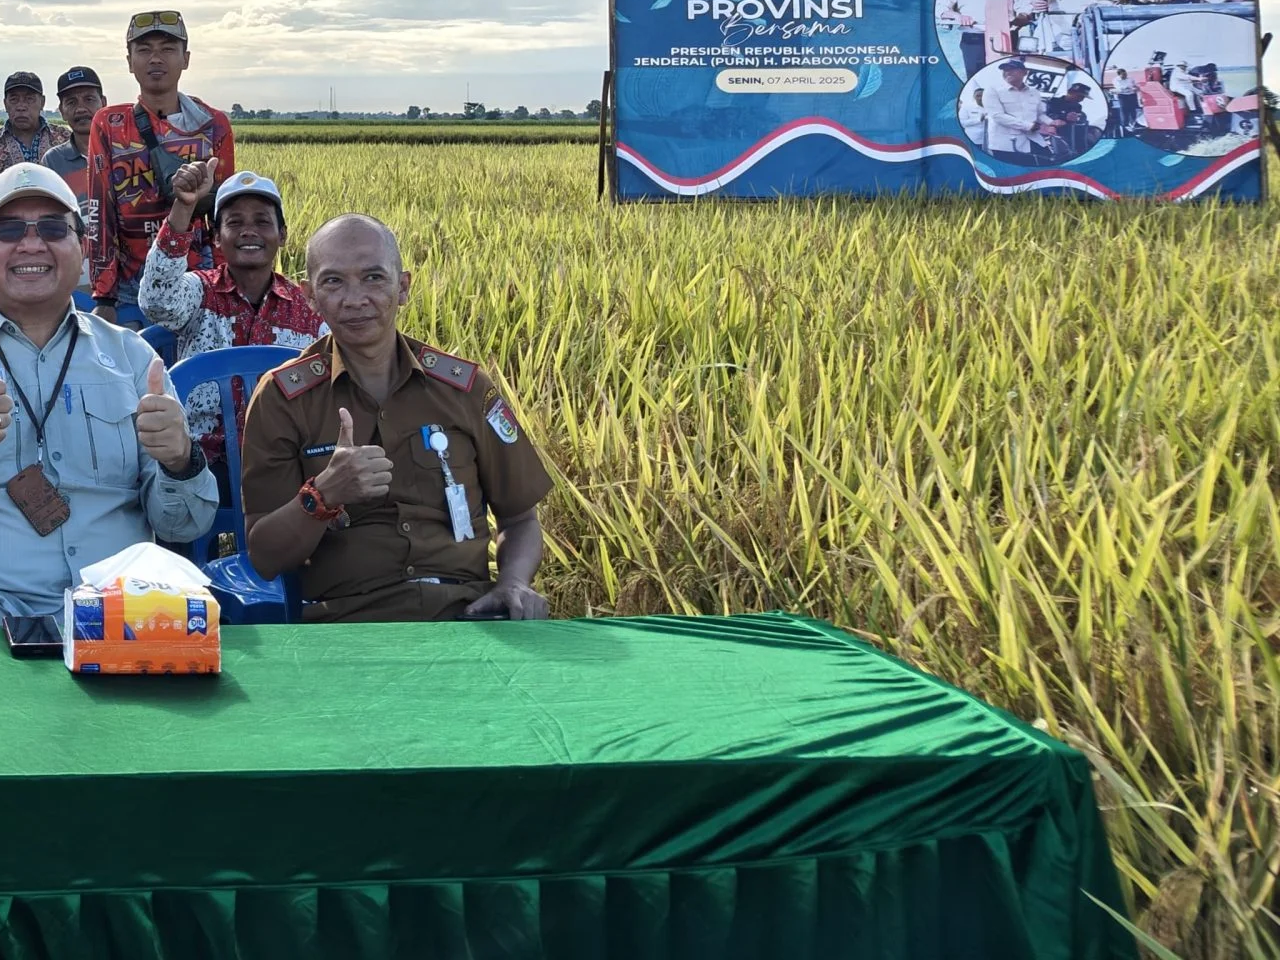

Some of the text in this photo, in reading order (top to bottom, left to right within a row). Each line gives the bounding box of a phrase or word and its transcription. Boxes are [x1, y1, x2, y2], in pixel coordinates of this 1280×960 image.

[720, 12, 852, 47] Bersama
[670, 45, 900, 56] PRESIDEN REPUBLIK INDONESIA
[634, 55, 939, 67] JENDERAL (PURN) H. PRABOWO SUBIANTO
[728, 76, 846, 86] SENIN, 07 APRIL 2025
